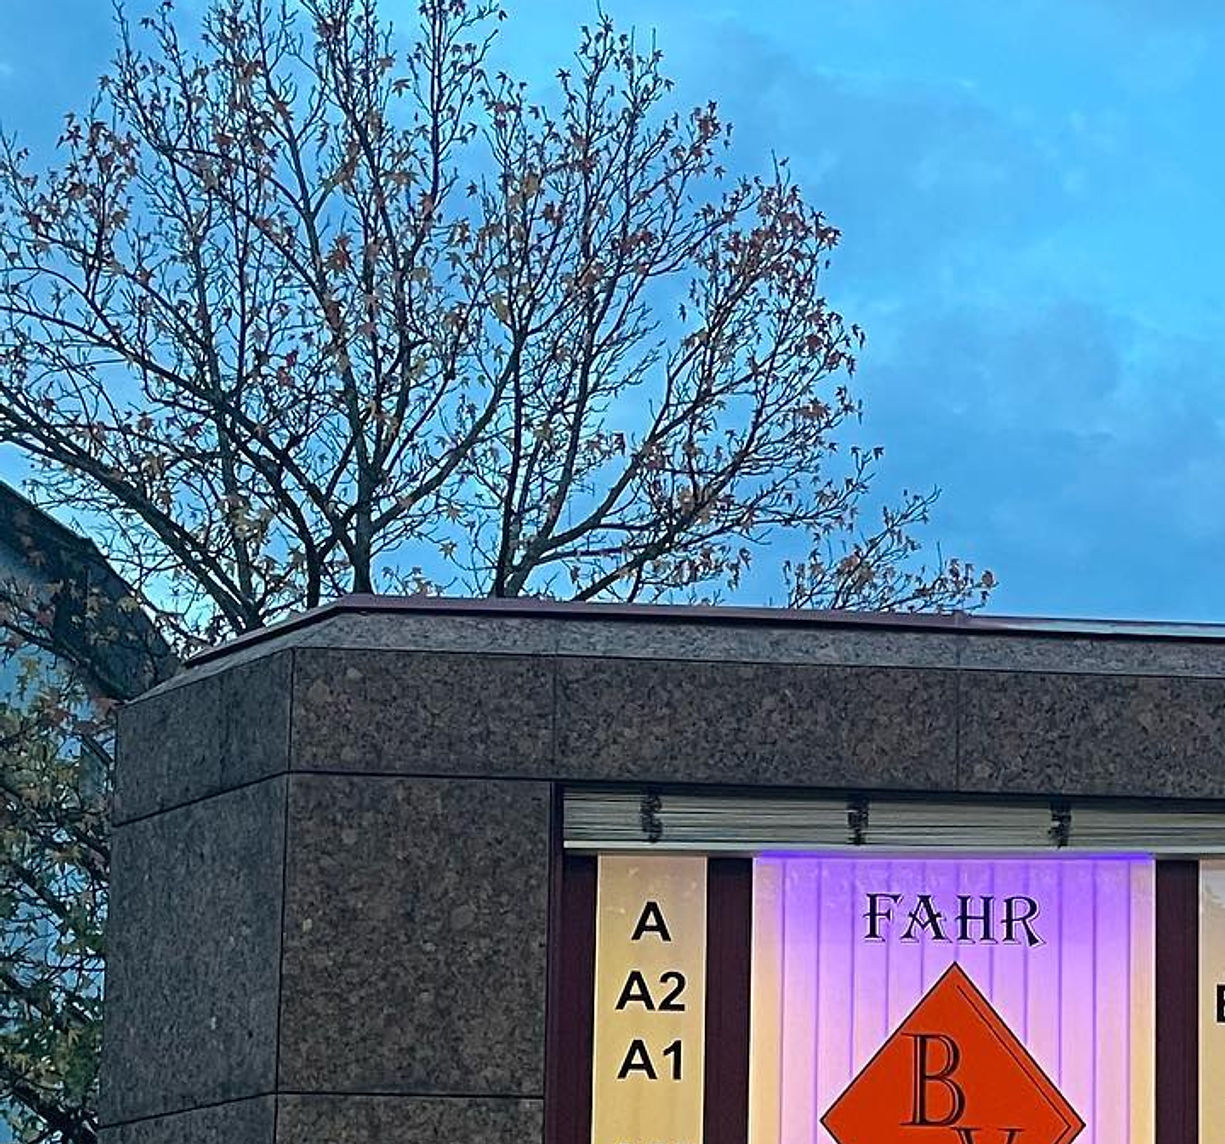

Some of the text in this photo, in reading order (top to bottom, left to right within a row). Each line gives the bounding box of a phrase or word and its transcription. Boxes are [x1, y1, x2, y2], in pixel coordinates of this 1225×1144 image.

[632, 902, 671, 941] A
[863, 892, 1046, 946] FAHR
[616, 971, 685, 1011] A2
[618, 1040, 681, 1079] A1
[903, 1033, 966, 1127] B
